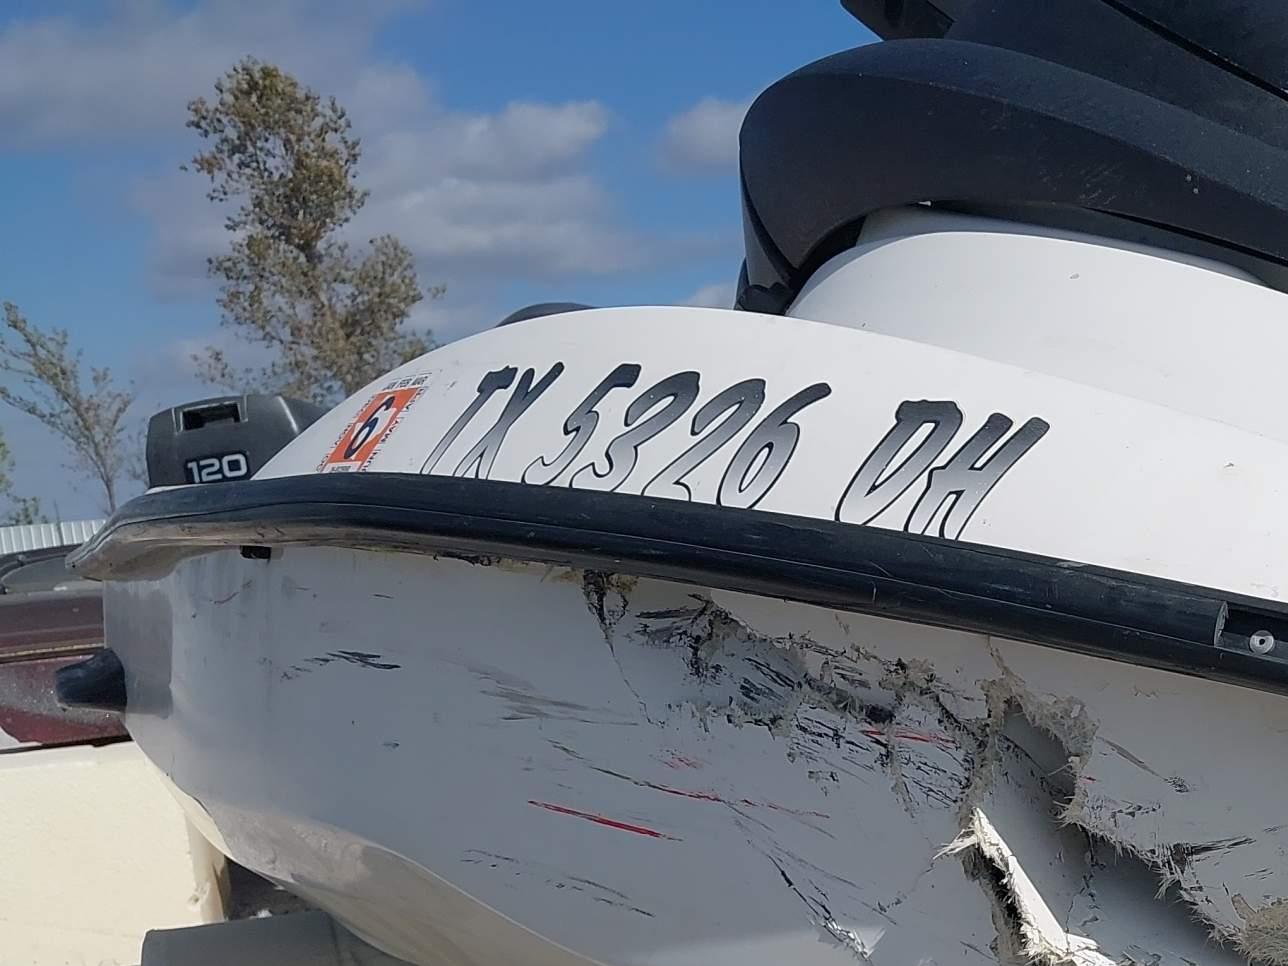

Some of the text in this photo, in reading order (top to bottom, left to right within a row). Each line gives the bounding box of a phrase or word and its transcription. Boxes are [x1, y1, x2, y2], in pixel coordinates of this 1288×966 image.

[343, 396, 396, 460] 6
[420, 361, 1050, 541] TX 5326 DH
[187, 453, 248, 484] 120
